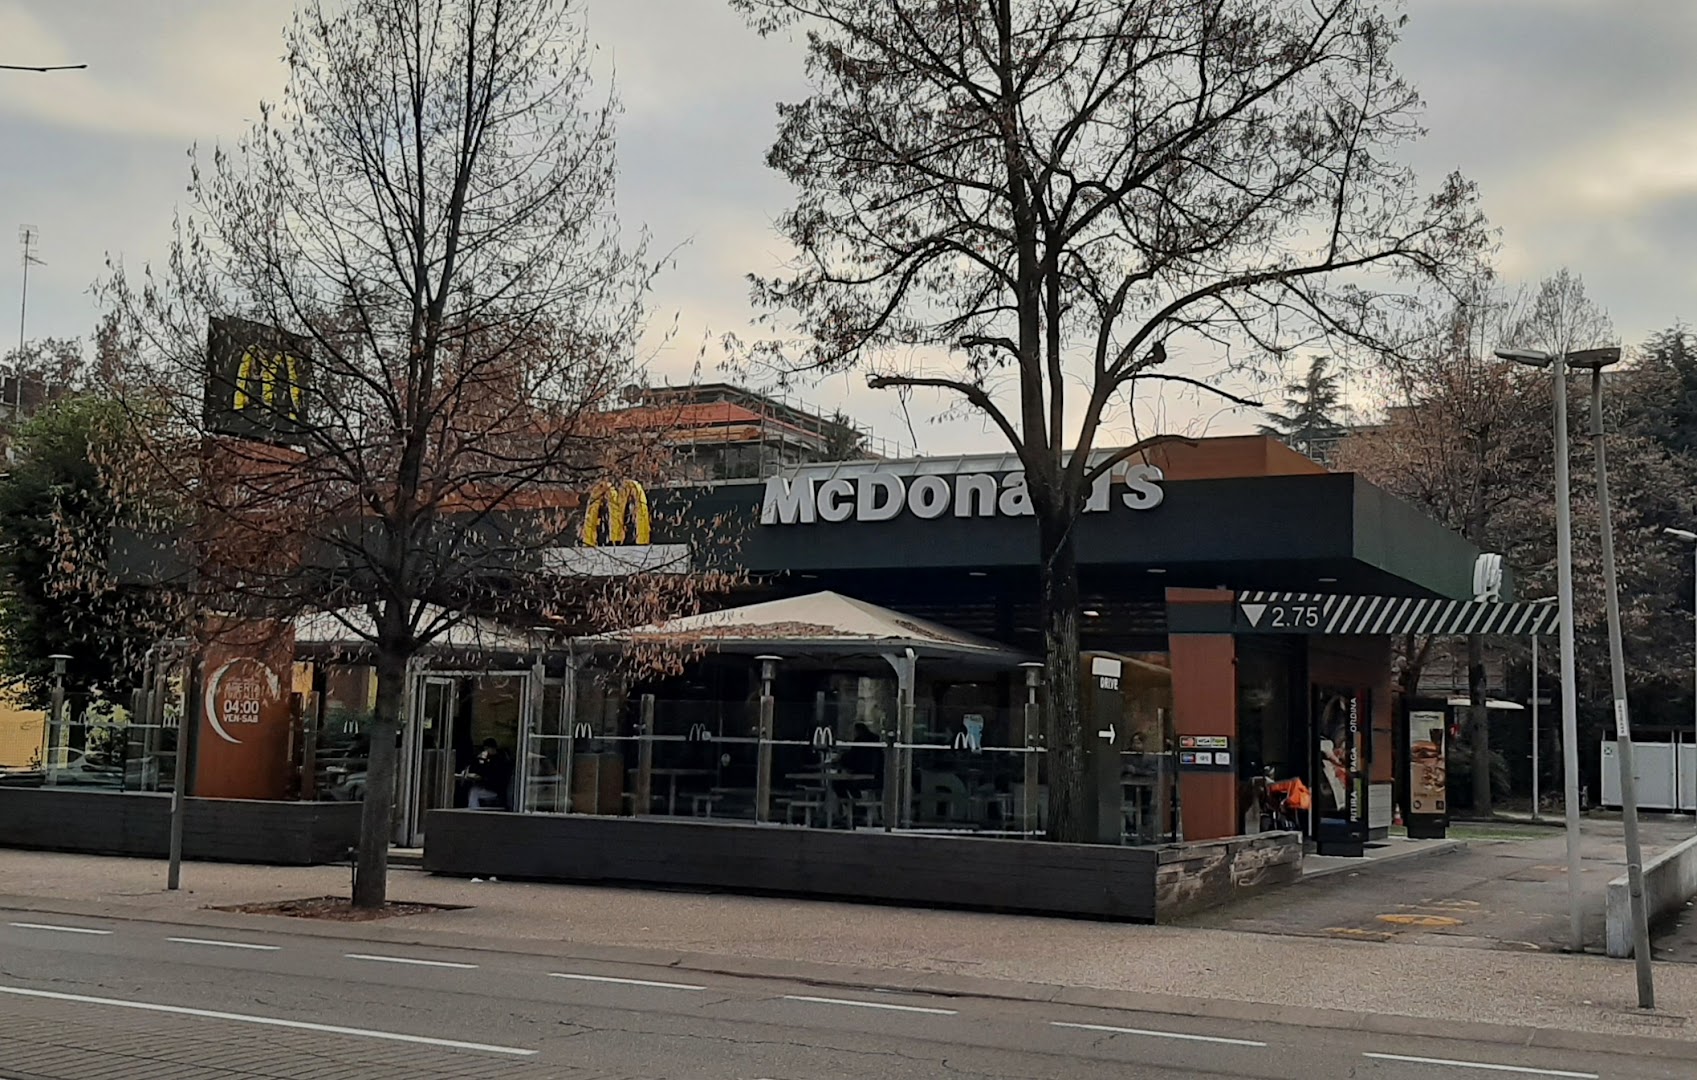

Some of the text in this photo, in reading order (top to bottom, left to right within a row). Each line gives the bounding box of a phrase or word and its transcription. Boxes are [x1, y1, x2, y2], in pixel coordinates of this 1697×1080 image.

[760, 460, 1164, 525] McDonal's
[1271, 606, 1319, 627] 2.75
[223, 699, 260, 714] 04:00
[223, 713, 259, 723] VEN-SAB
[1349, 697, 1358, 733] ORDINA
[1349, 747, 1358, 773] PAGA
[1349, 791, 1359, 823] RITIRA
